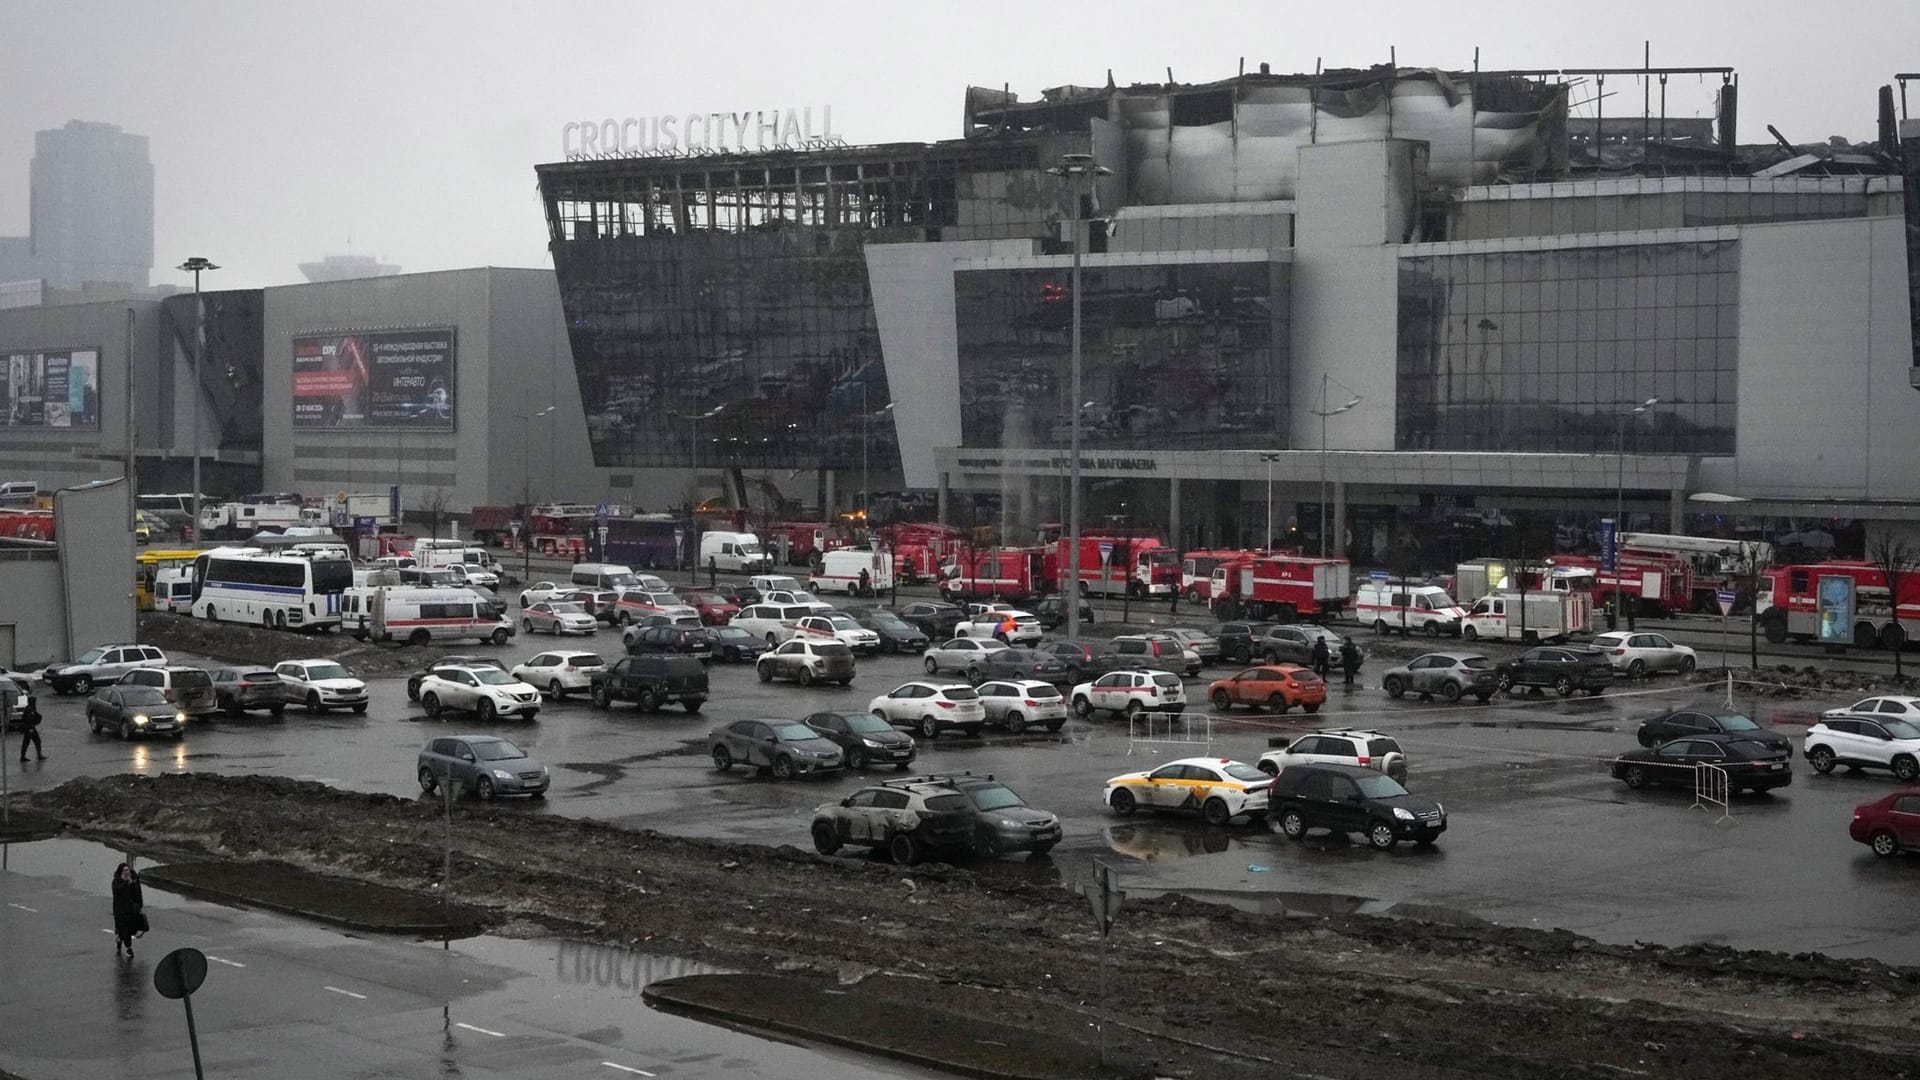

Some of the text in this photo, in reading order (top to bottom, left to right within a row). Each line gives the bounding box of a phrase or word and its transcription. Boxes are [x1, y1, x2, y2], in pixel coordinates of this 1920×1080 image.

[562, 104, 842, 156] CROCUS CITY HALL
[1051, 458, 1096, 469] МУСИМА
[1097, 459, 1157, 471] МАГОМАЕВА
